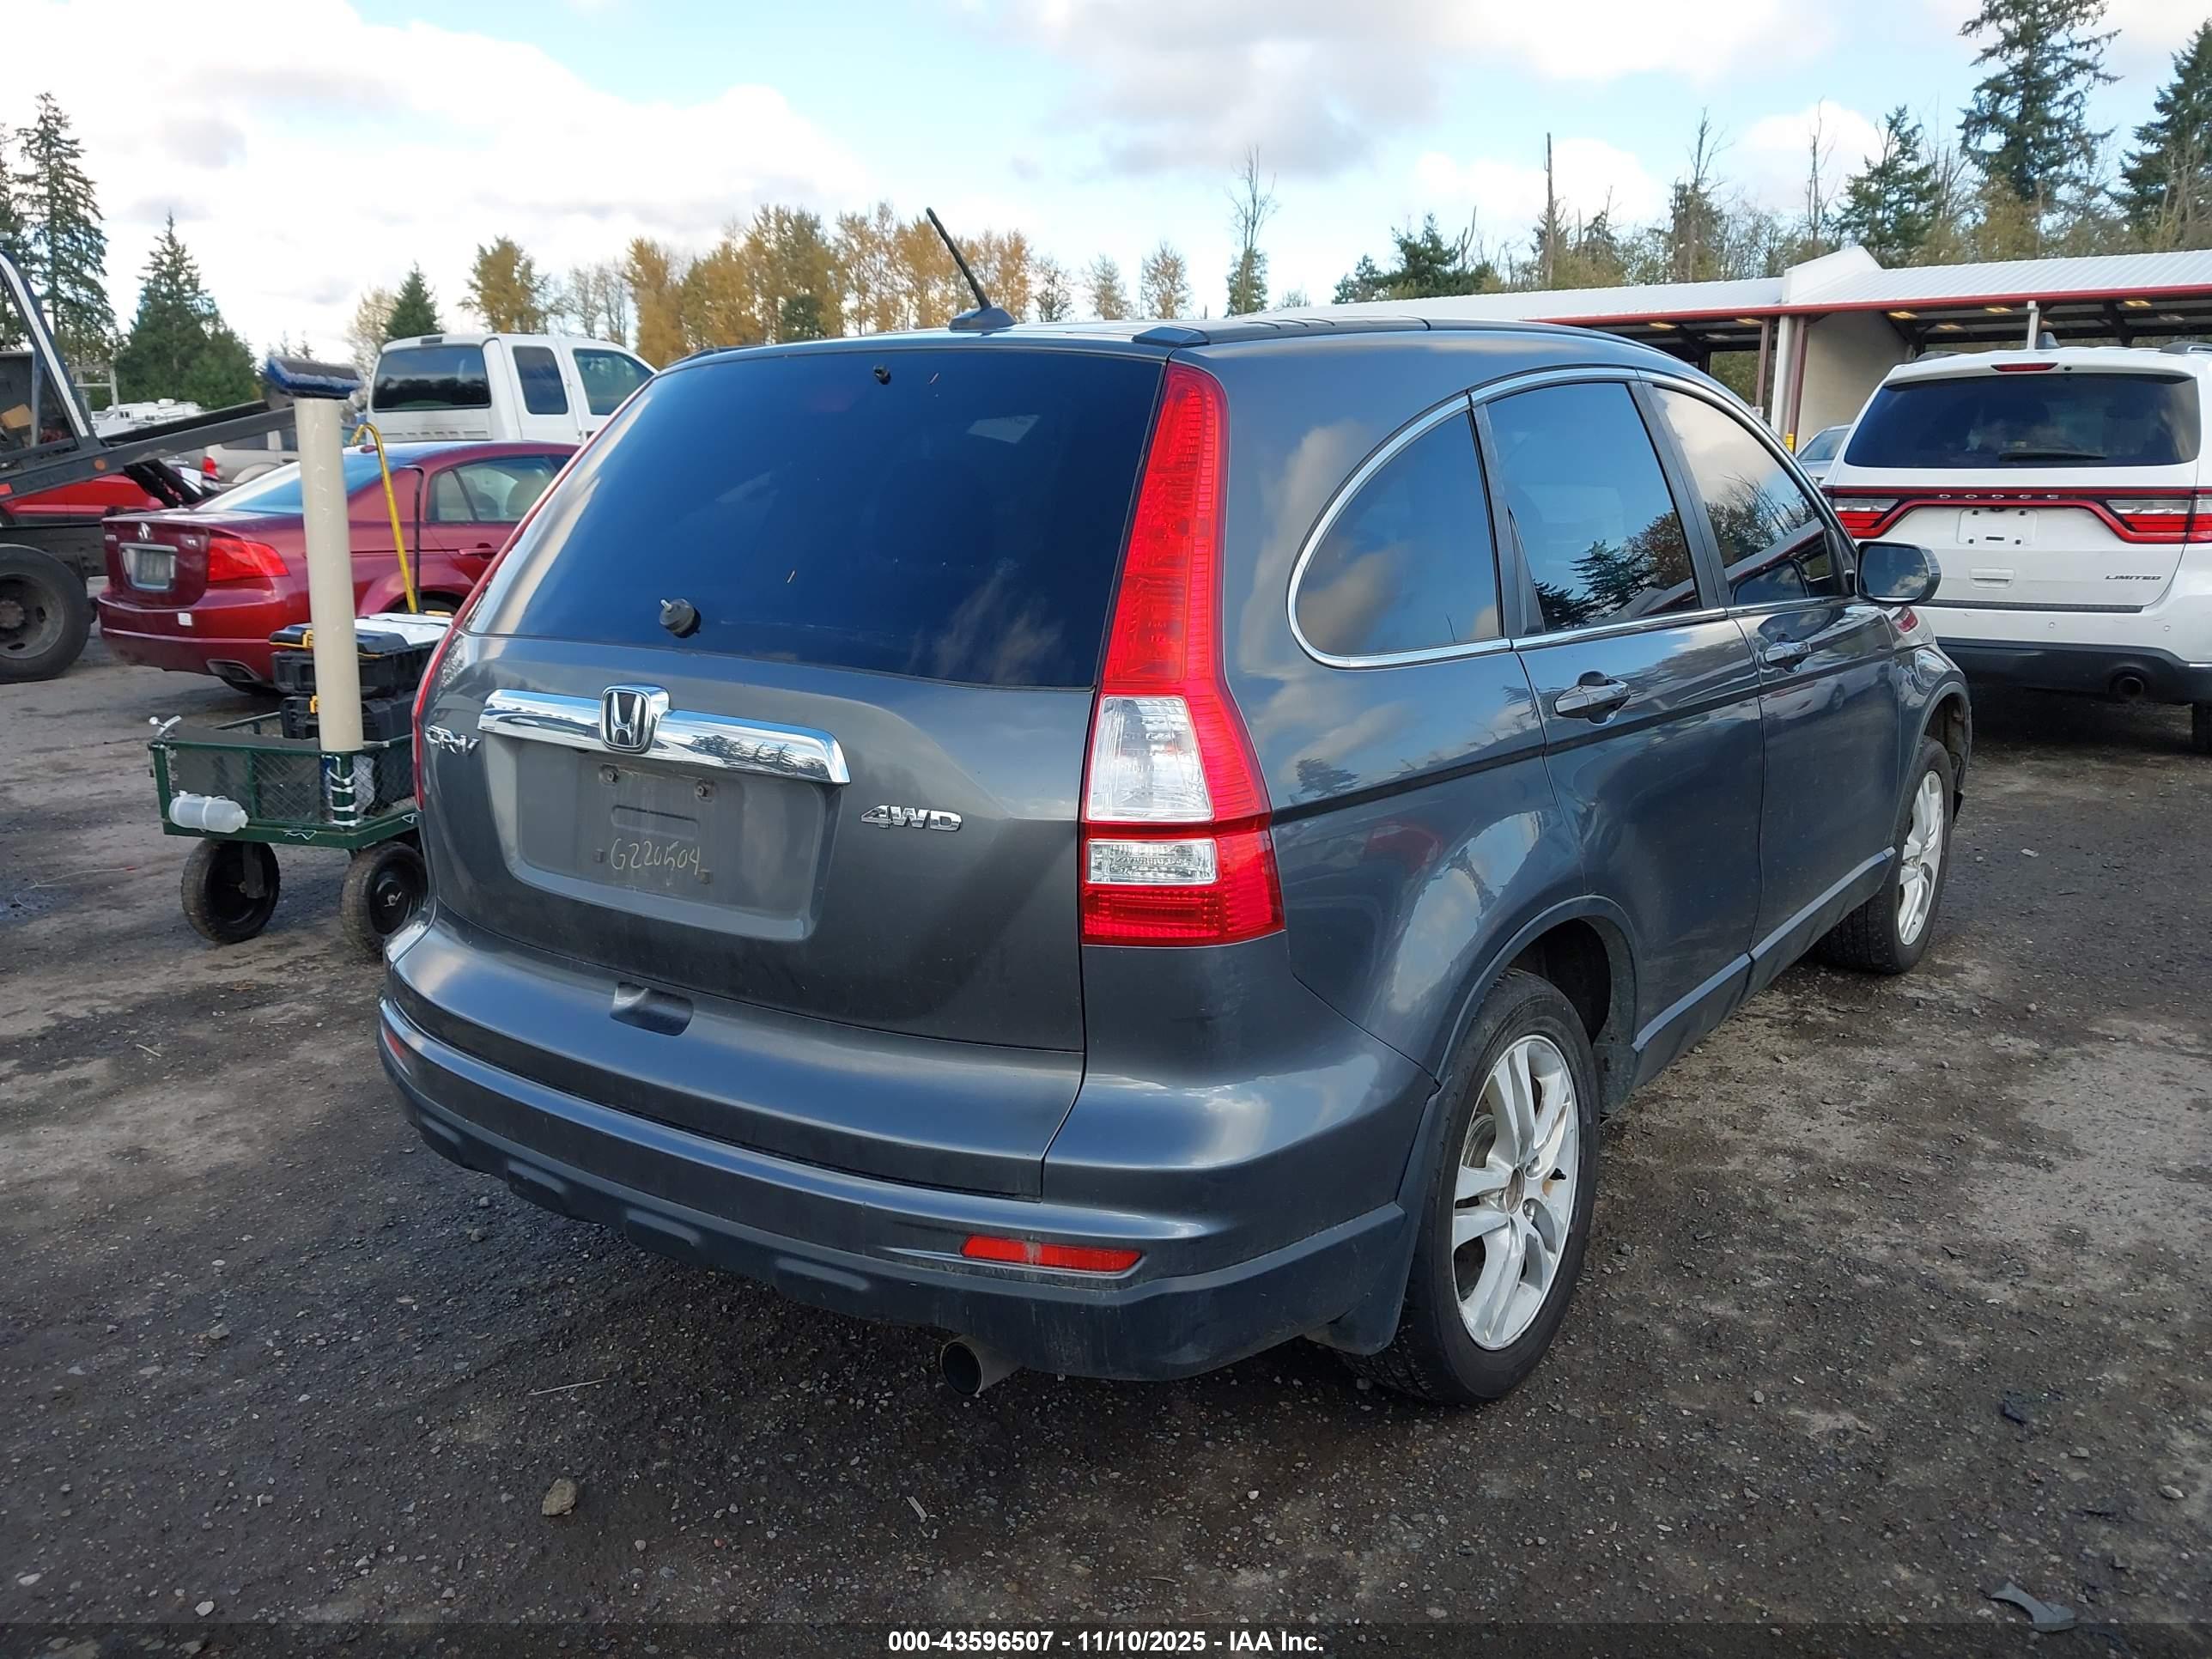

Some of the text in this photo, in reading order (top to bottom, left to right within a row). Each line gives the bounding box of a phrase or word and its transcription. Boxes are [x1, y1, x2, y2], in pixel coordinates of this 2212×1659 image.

[425, 725, 481, 756] CR-V
[860, 805, 963, 832] 4WD
[610, 837, 701, 876] G220504
